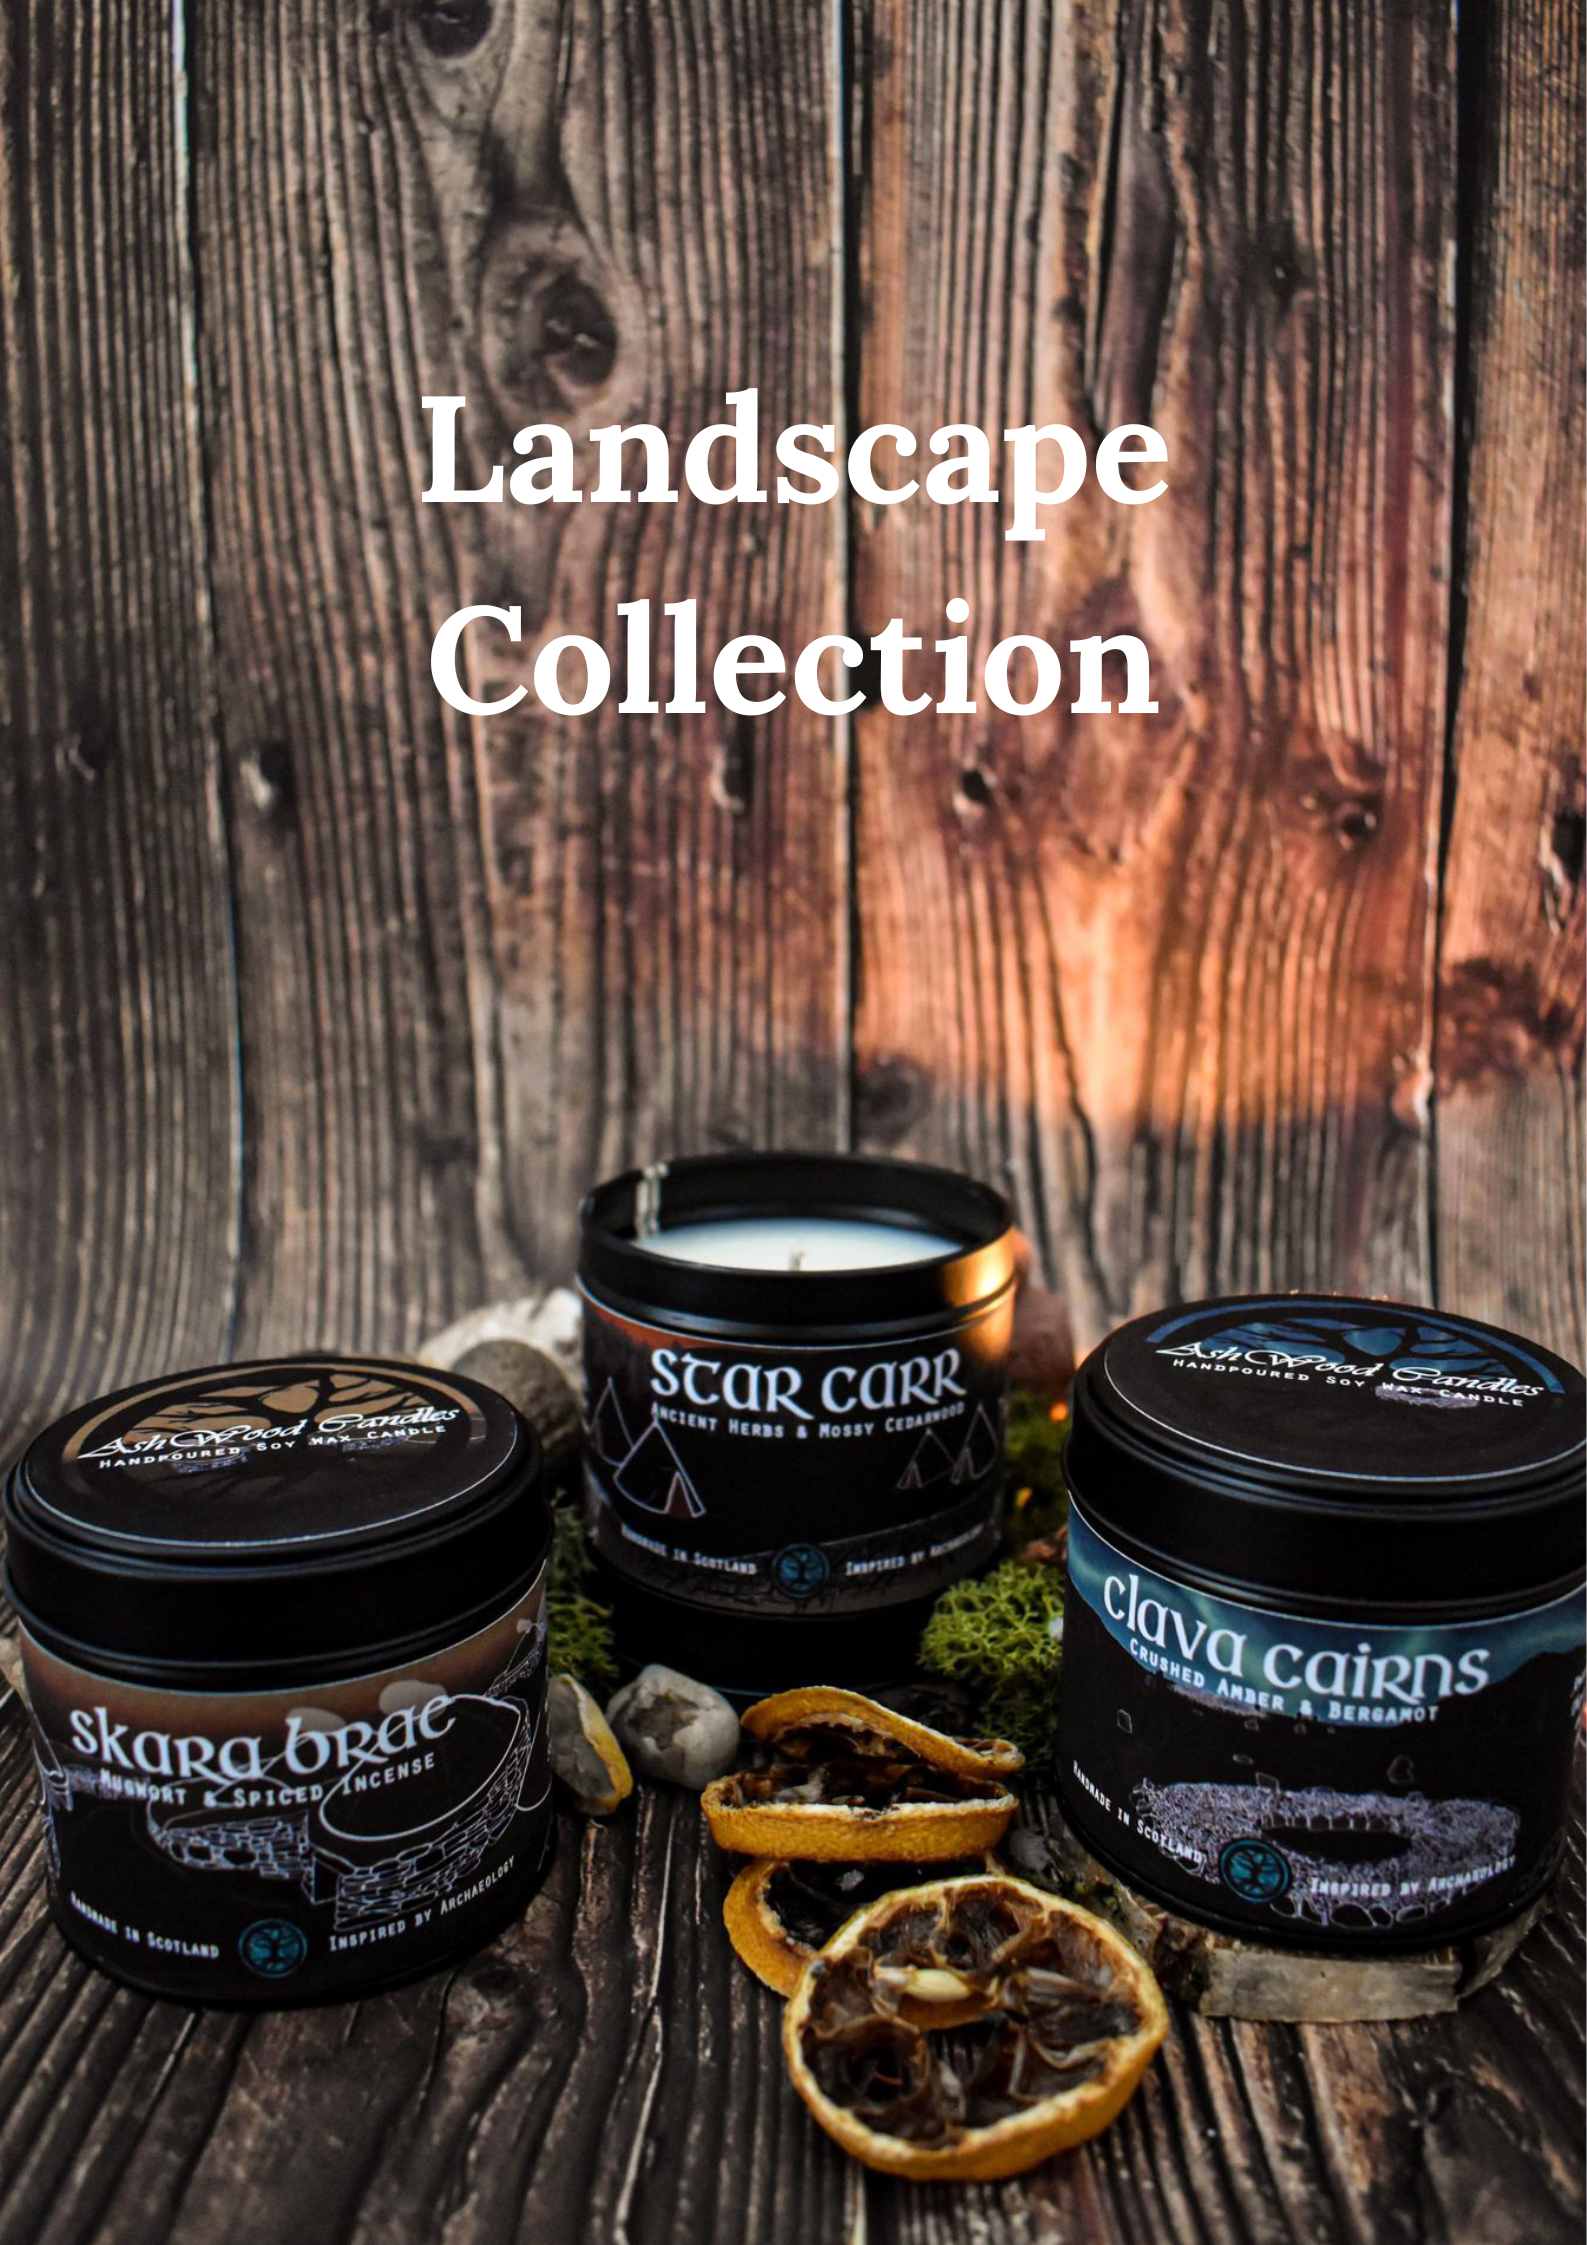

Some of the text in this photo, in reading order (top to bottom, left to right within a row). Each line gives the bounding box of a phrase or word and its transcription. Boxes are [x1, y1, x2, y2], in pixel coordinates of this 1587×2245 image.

[1173, 1359, 1524, 1407] HANDPOURED SOY WAX CANDLE
[1392, 1366, 1544, 1396] Candles
[318, 1406, 460, 1432] Candles
[651, 1402, 718, 1431] ANCIENT
[728, 1419, 784, 1438] HERBS
[819, 1422, 875, 1438] MOSSY
[885, 1402, 965, 1432] CEDARWOOD
[99, 1425, 446, 1469] HANDPOURED SOY WAX CANDLE
[1130, 1637, 1439, 1722] CRUSHED AMBER & BERGAMOT
[233, 1784, 324, 1808] SPICED
[342, 1752, 436, 1796] INCENSE
[1073, 1760, 1207, 1864] HANDMADE IN SCOTLAND
[329, 1855, 514, 1952] INSPIRED BY ARCHAEOLOGY
[1310, 1876, 1391, 1897] INSPIRED
[147, 1930, 220, 1960] SCOTLAND
